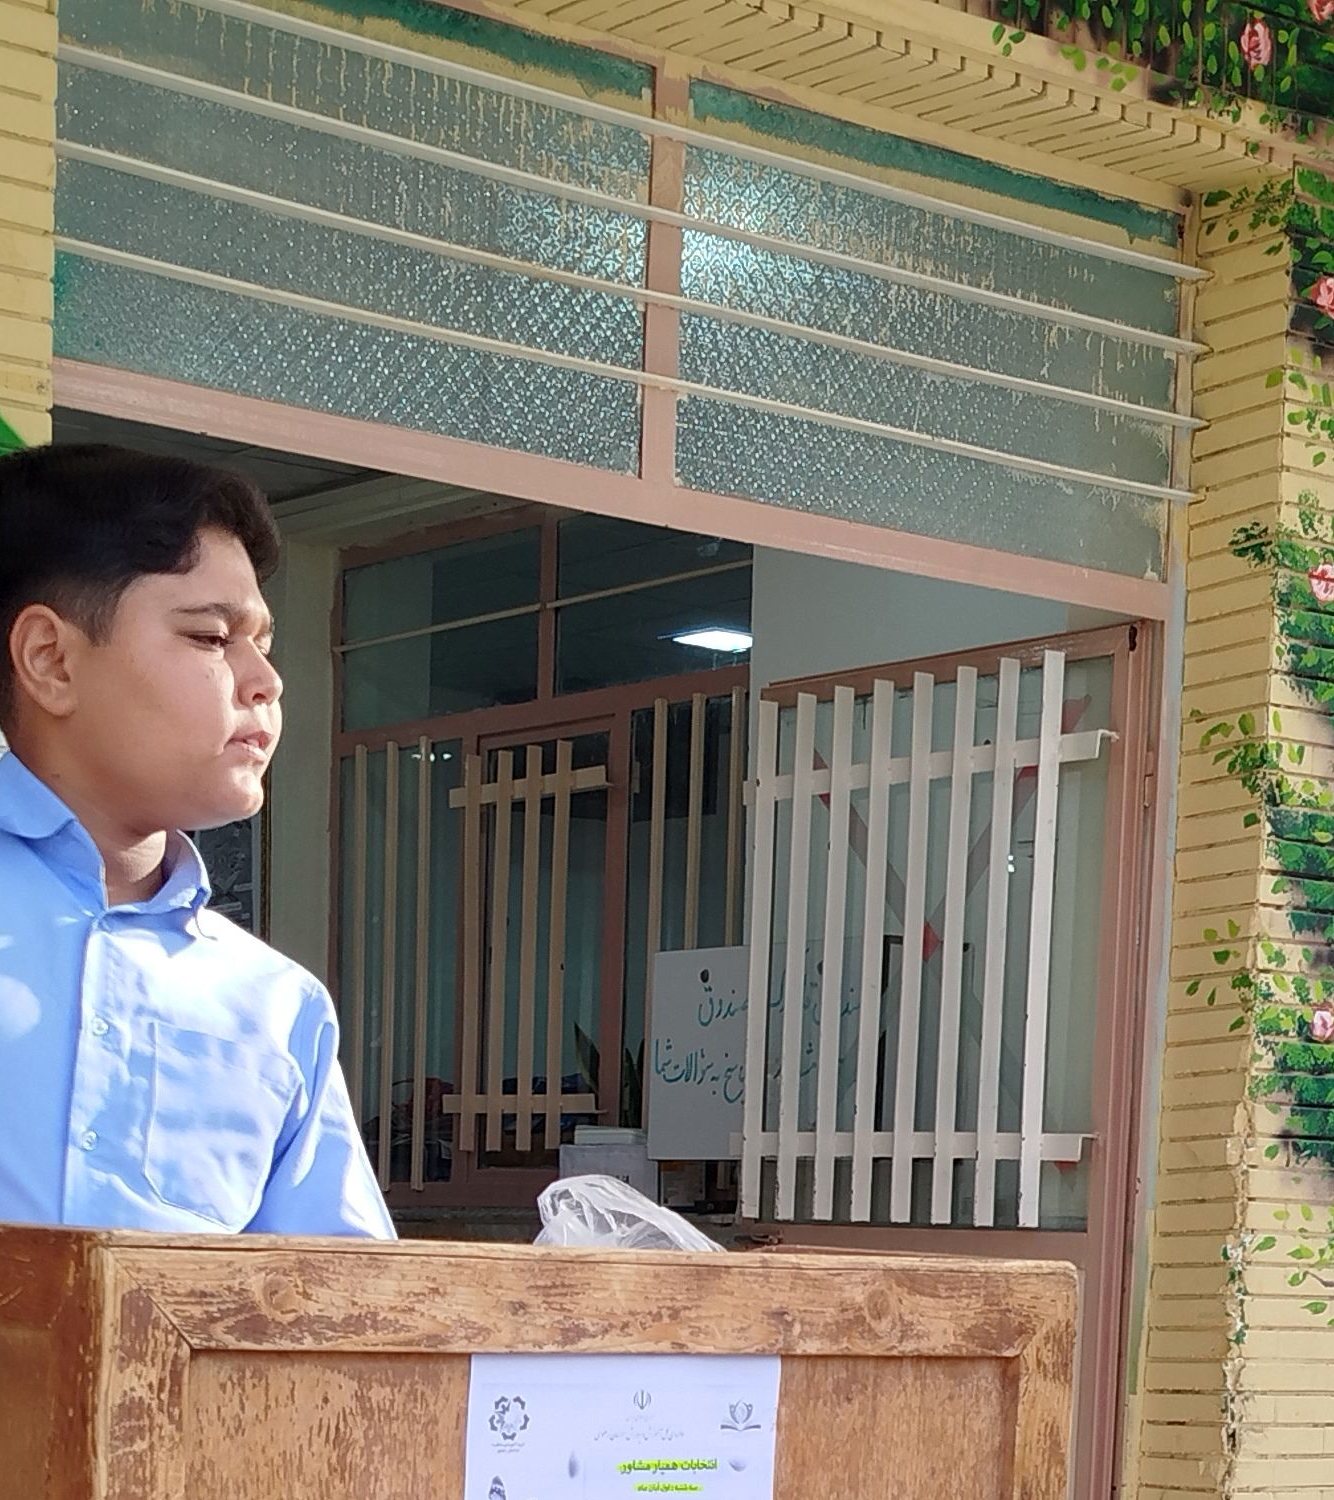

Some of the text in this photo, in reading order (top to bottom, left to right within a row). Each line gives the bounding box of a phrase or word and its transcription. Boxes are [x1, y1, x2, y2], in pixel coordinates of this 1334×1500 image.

[619, 1457, 718, 1476] انتخابات همیار مشاور
